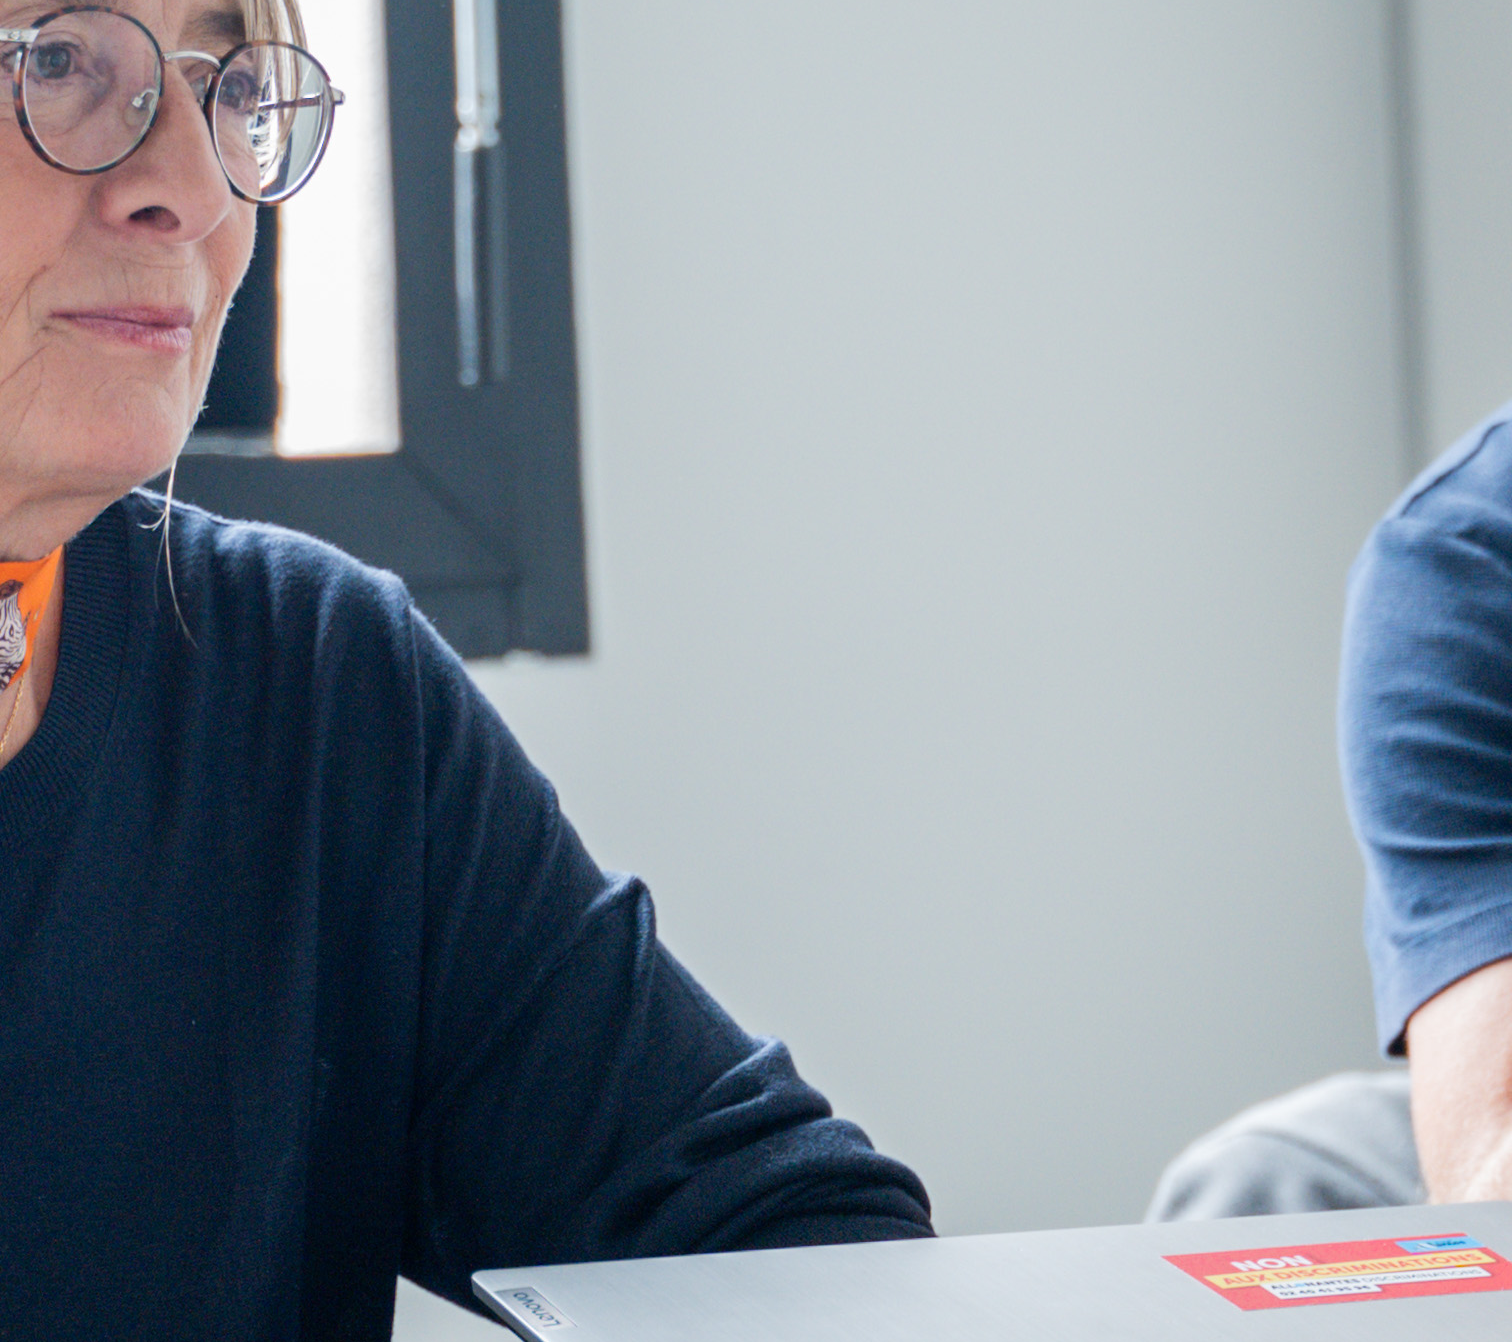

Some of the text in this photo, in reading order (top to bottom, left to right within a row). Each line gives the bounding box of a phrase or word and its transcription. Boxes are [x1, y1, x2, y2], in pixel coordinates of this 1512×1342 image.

[1223, 1252, 1483, 1285] AUX DISCRIMINATIONS
[1230, 1255, 1313, 1272] NON
[1362, 1268, 1483, 1284] DISCRIMINATIONS
[513, 1292, 562, 1327] Lenovo
